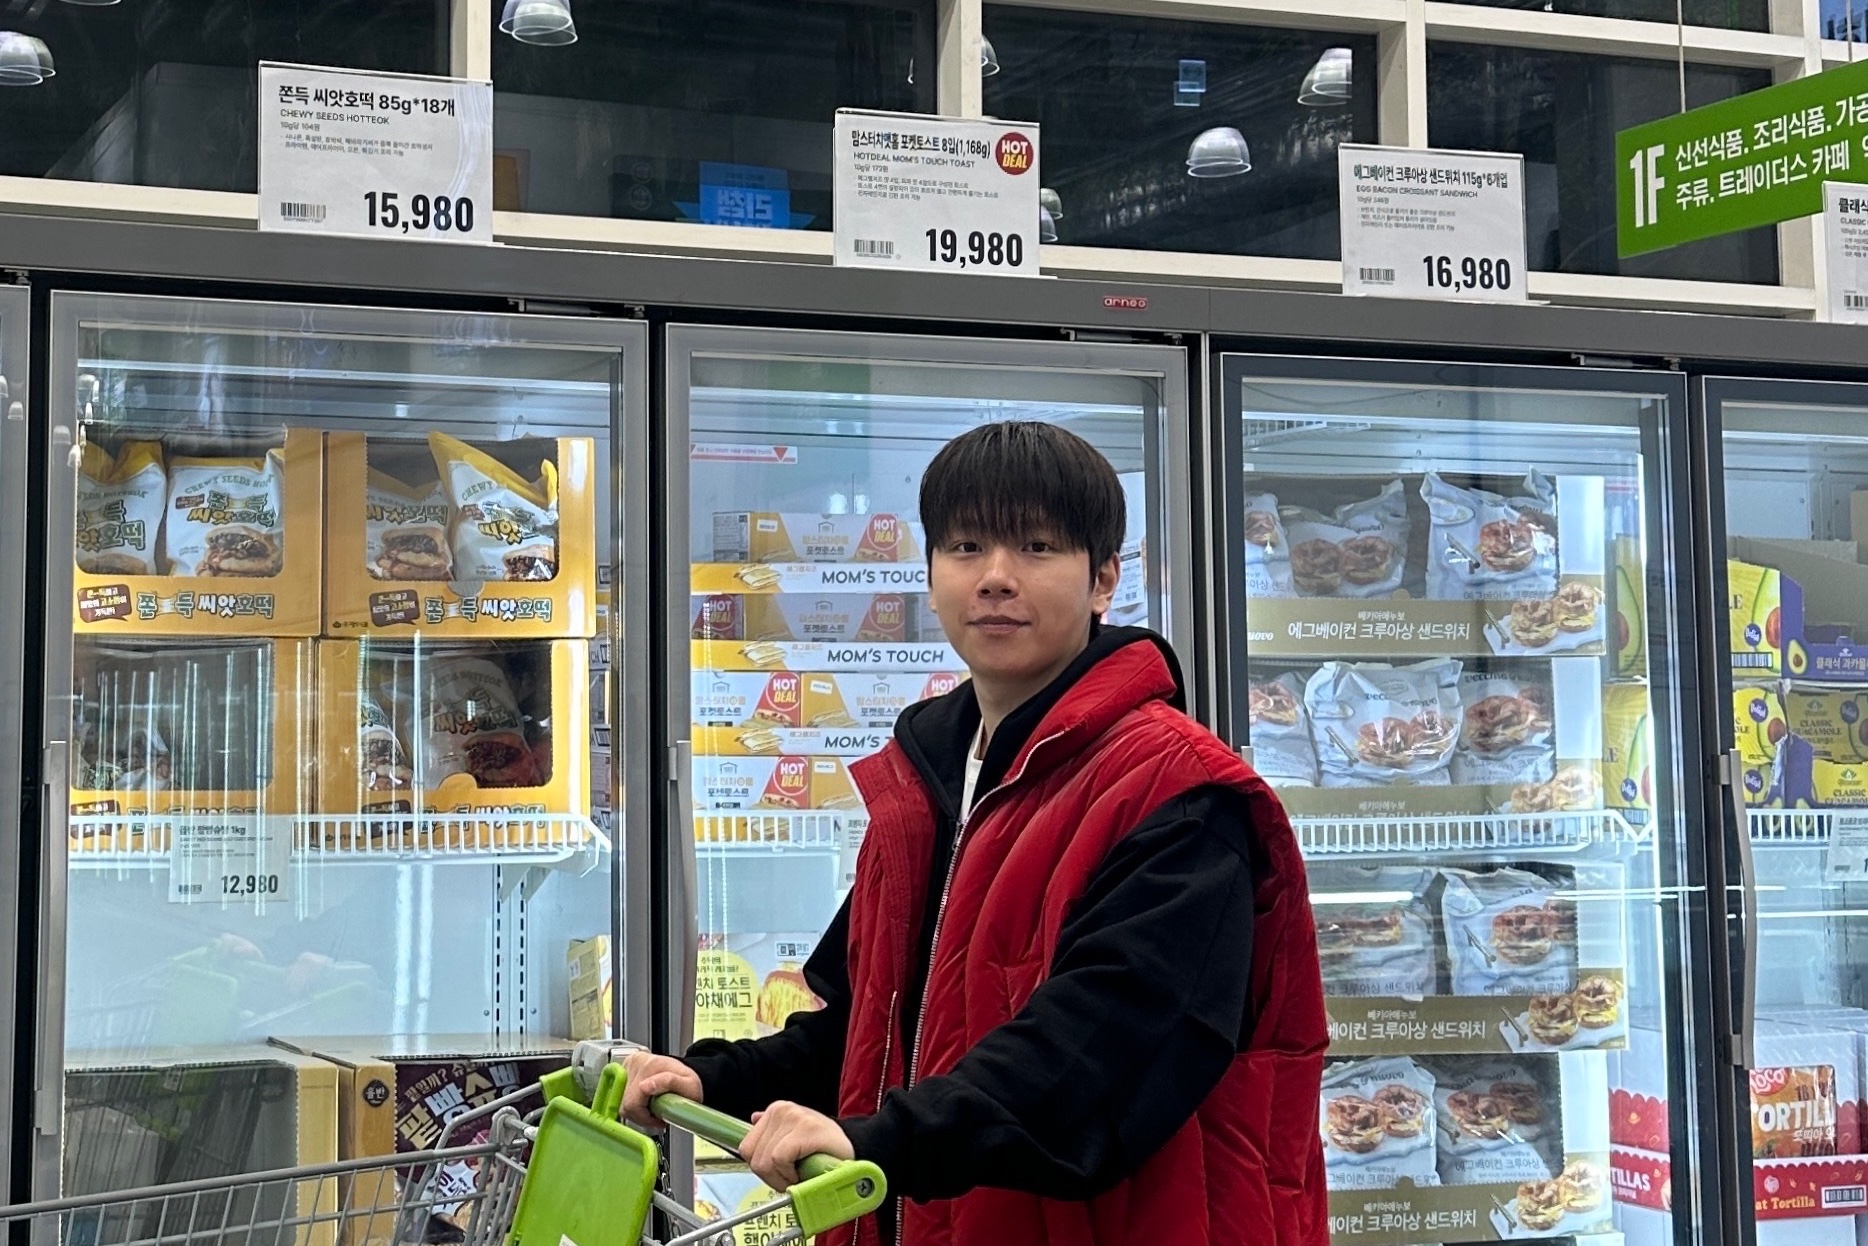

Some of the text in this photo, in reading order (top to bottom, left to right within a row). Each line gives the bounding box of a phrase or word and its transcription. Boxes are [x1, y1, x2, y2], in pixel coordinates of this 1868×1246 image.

[279, 85, 309, 105] 쫀득
[313, 88, 375, 110] 씨앗호떡
[280, 109, 390, 125] CHEWY SEEDS HOTTEOK
[901, 134, 941, 152] 포켓토스트
[941, 137, 991, 159] 8입(1,168g)
[1676, 128, 1749, 172] 신선식품,
[1753, 105, 1832, 150] 조리식품,
[1001, 140, 1028, 155] HOT
[853, 152, 891, 162] HOTDEAL
[921, 157, 948, 166] TOUCH
[950, 159, 976, 168] TOAST
[1002, 154, 1028, 169] DEAL
[1396, 167, 1428, 184] 크루아상
[1429, 169, 1461, 186] 샌드위치
[1676, 178, 1714, 211] 주류,
[1718, 153, 1807, 198] 트레이더스
[1812, 139, 1849, 176] 카페
[1630, 143, 1665, 228] 1F
[1439, 189, 1479, 199] SANDWICH
[364, 191, 474, 234] 15,980
[926, 228, 1023, 268] 19,980
[1423, 255, 1511, 293] 16,980
[874, 519, 896, 530] HOT
[873, 530, 895, 543] DEAL
[821, 568, 927, 584] MOM'S TOUC
[136, 591, 195, 619] 쫀득
[197, 593, 275, 619] 씨앗호떡
[424, 596, 479, 624] 쫀득
[481, 597, 553, 623] 씨앗호떡
[876, 600, 900, 612] HOT
[876, 612, 900, 625] DEAL
[1288, 621, 1470, 641] 에그베이컨 크루아상 샌드위치
[827, 648, 944, 663] MOM'S TOUCH
[1842, 657, 1868, 670] 과카몰
[772, 678, 797, 691] HOT
[930, 678, 955, 692] HOT
[773, 690, 797, 704] DEAL
[1800, 719, 1832, 727] CLASSIC
[824, 734, 880, 750] MOM'S
[780, 763, 805, 775] HOT
[780, 775, 805, 788] DEAL
[1832, 788, 1867, 797] CLASSIC
[221, 874, 279, 897] 12,980
[717, 976, 751, 990] 토스트
[696, 992, 753, 1009] 야채에그
[1371, 1022, 1428, 1040] 크루아상
[1430, 1019, 1486, 1039] 샌드위치
[1327, 1173, 1366, 1185] 그베이컨
[1611, 1166, 1651, 1191] TILLAS
[1770, 1195, 1816, 1210] Tortilla
[1366, 1209, 1478, 1232] 크루아상 샌드위치
